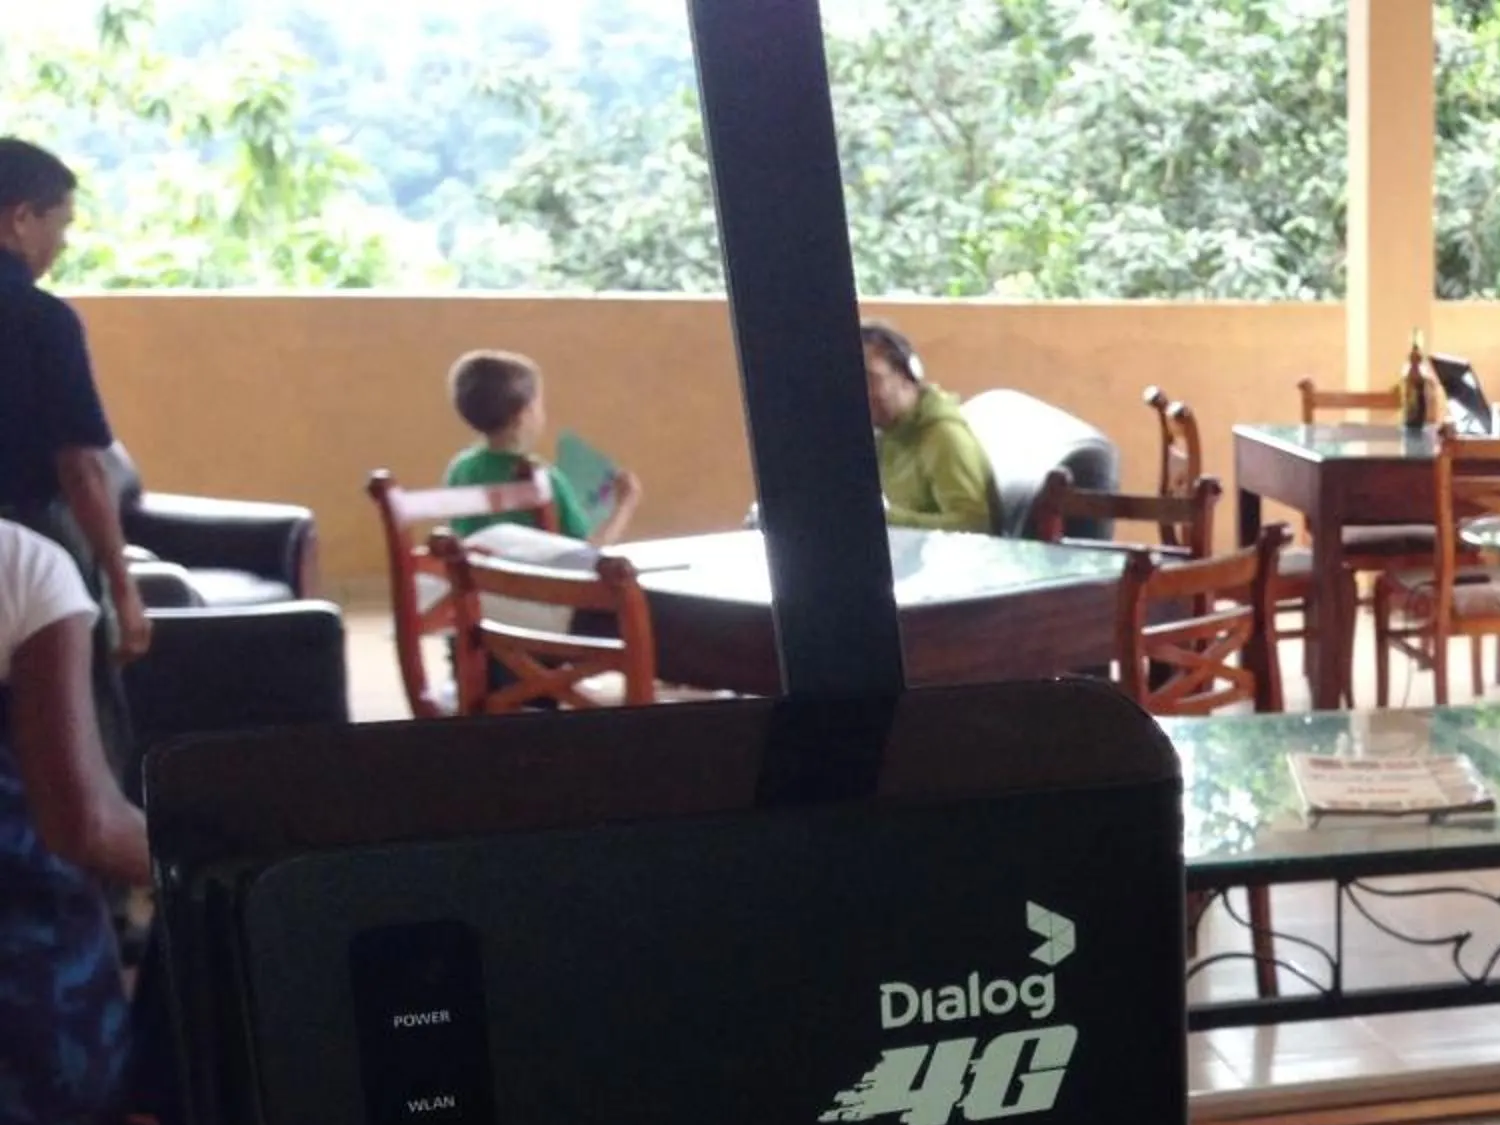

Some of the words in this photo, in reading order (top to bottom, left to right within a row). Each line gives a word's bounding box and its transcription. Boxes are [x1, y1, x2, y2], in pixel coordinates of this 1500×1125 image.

[879, 969, 1056, 1030] Dialog
[393, 1009, 452, 1029] POWER
[407, 1095, 457, 1114] WLAN
